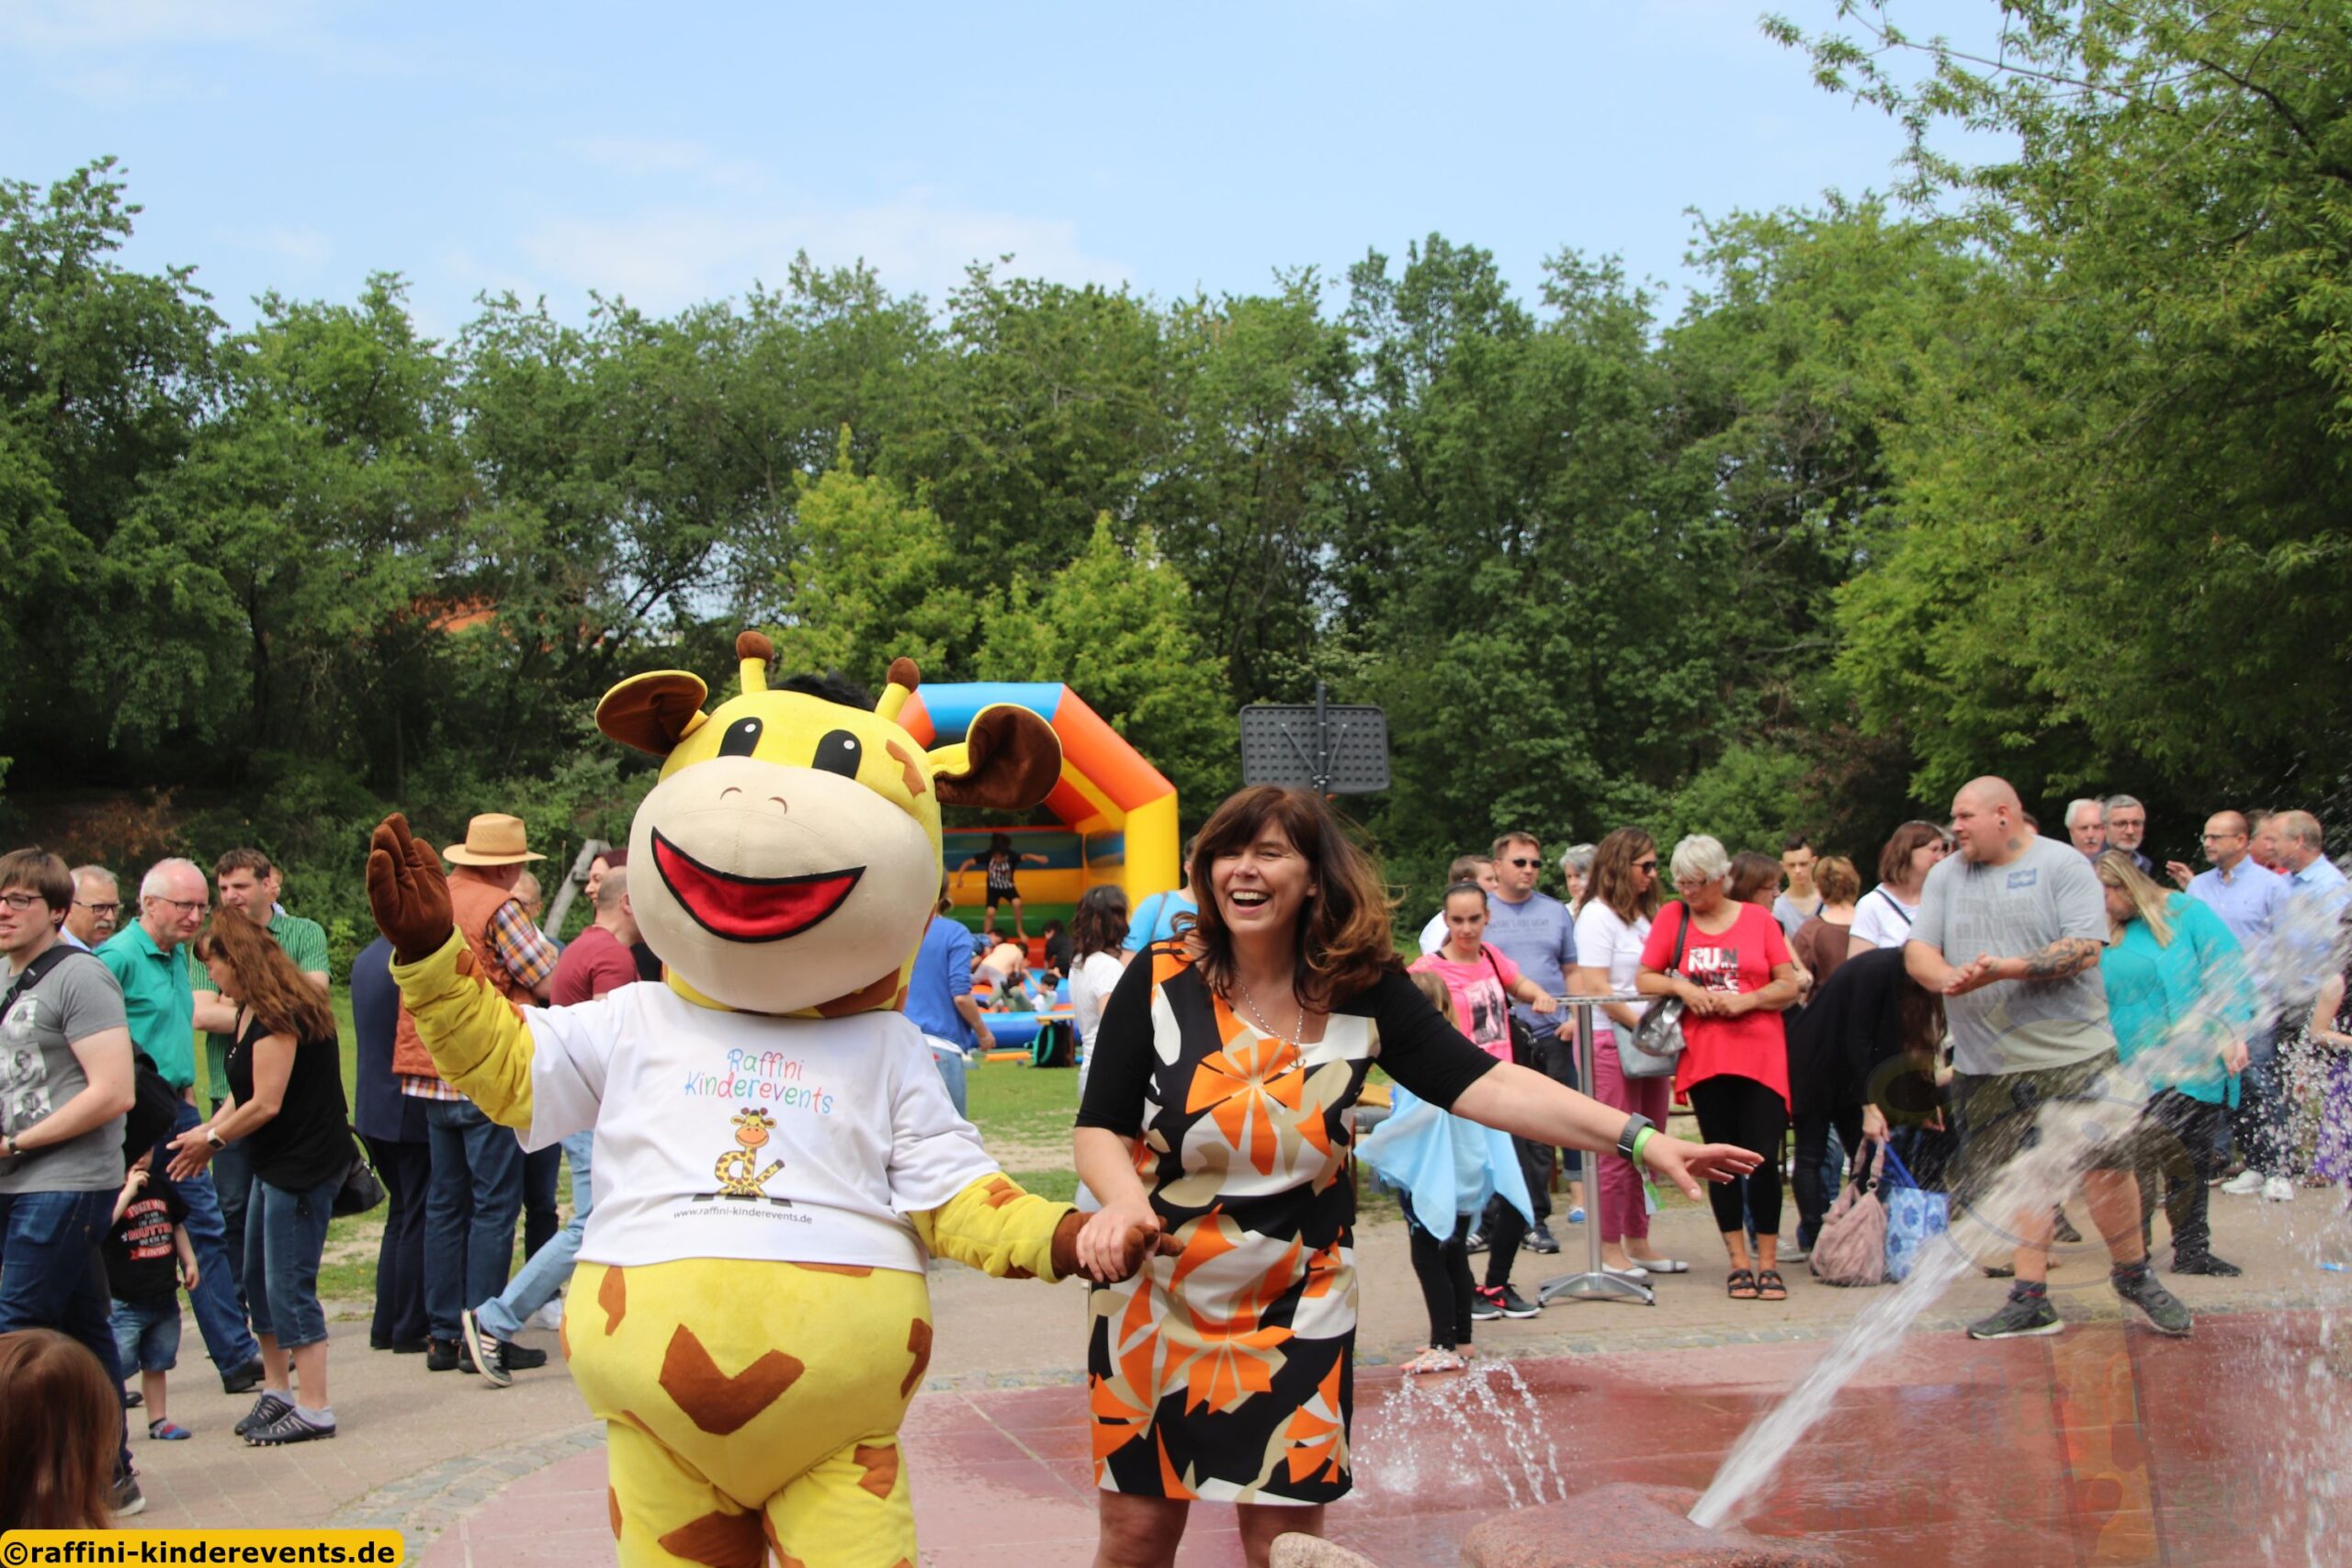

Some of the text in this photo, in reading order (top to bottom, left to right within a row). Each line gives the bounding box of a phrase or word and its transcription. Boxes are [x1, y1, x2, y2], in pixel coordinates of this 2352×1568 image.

[727, 1048, 805, 1081] Raffini
[684, 1071, 834, 1114] Kinderevents
[673, 1205, 813, 1224] www.raffini-kinderevents.de
